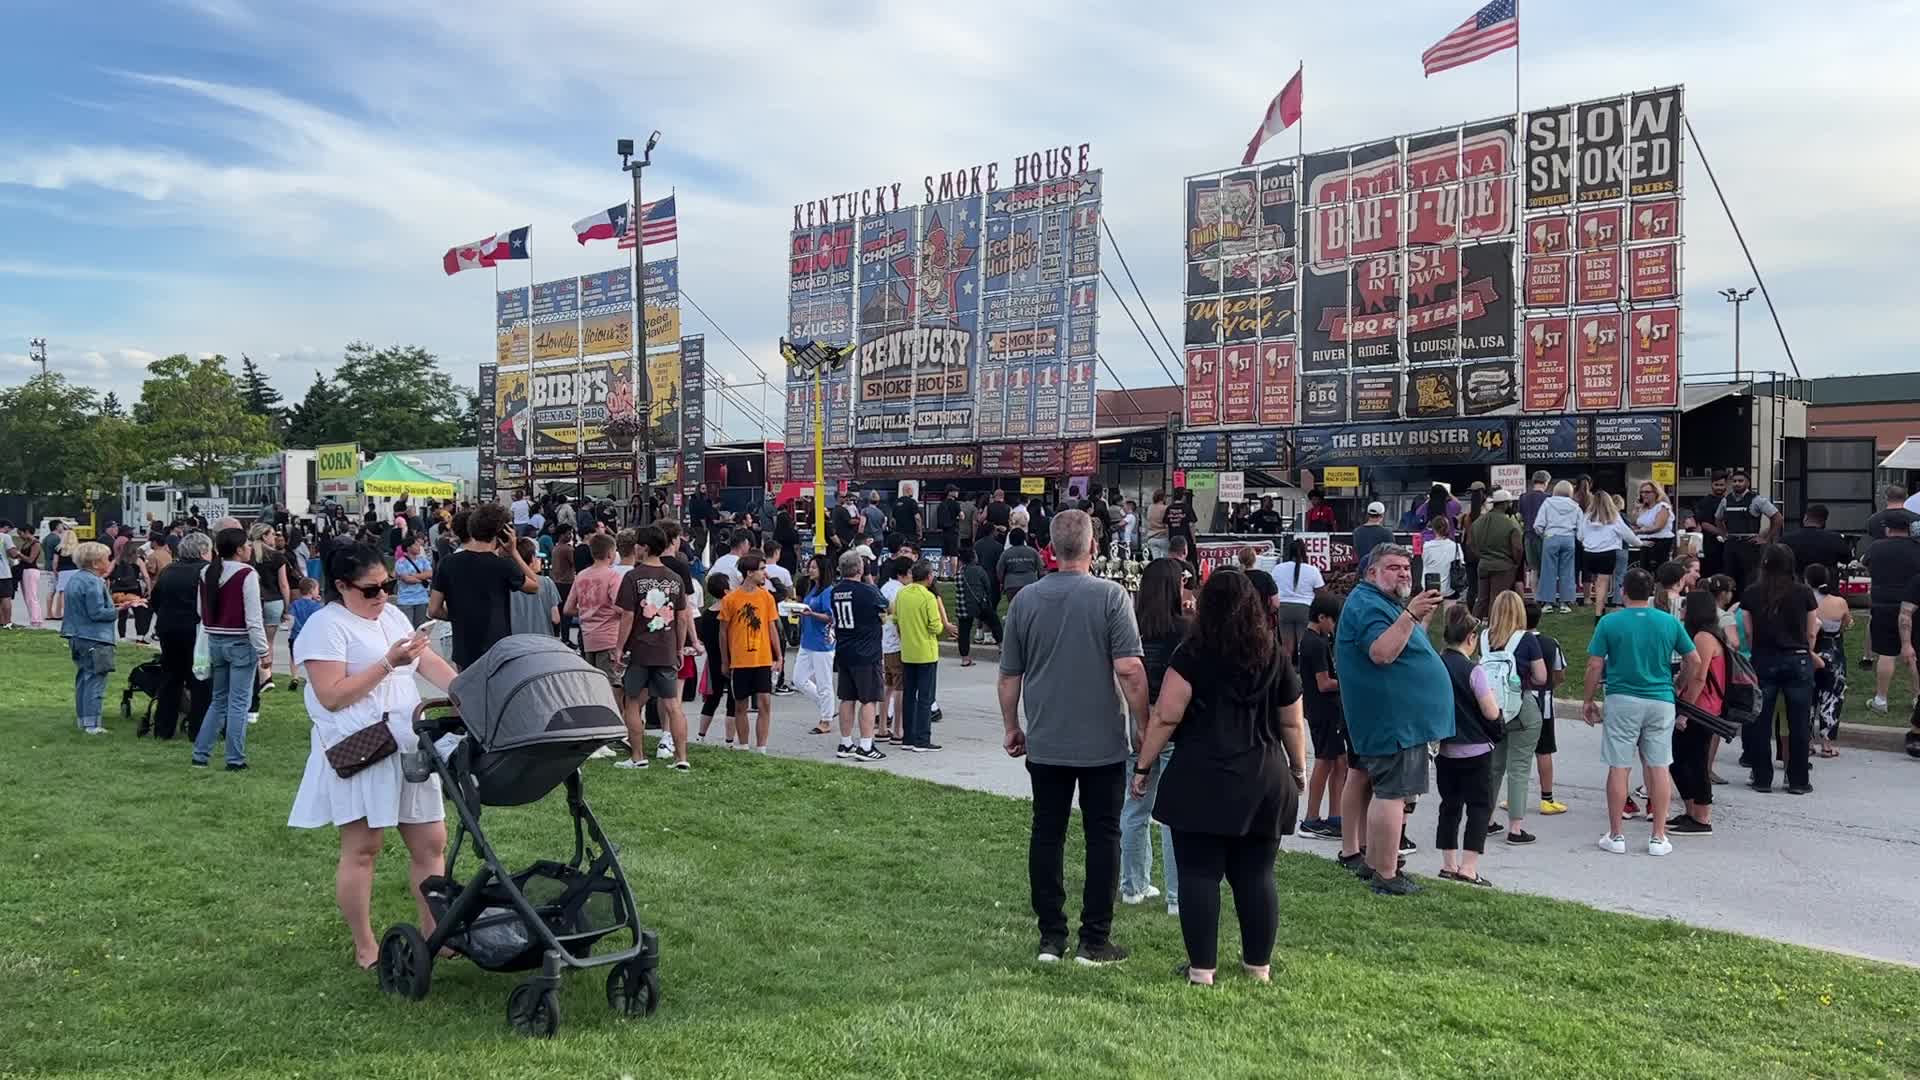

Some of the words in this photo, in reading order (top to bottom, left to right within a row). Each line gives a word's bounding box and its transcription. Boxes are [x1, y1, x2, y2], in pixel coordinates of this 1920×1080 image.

[1529, 96, 1674, 151] SLOW
[1531, 138, 1671, 192] SMOKED
[1262, 174, 1293, 191] VOTE
[1330, 154, 1496, 203] LOUISIANA
[794, 183, 902, 231] KENTUCKY
[925, 163, 999, 203] SMOKE
[1015, 143, 1090, 186] HOUSE
[1580, 187, 1621, 201] STYLE
[1631, 180, 1674, 194] RIBS
[862, 219, 885, 231] VOTE
[988, 228, 1032, 258] Feeling
[862, 241, 906, 264] CHOICE
[1638, 249, 1667, 259] BEST
[1369, 246, 1448, 279] BEST
[1533, 264, 1560, 275] BEST
[1586, 258, 1612, 269] BEST
[1638, 265, 1666, 275] RIBS
[831, 270, 850, 284] RIBS
[1368, 277, 1385, 290] IN
[1393, 264, 1447, 289] TOWN
[1532, 274, 1561, 285] SAUCE
[1587, 269, 1611, 281] RIBS
[1190, 295, 1274, 321] Where
[1341, 318, 1379, 335] BBQ
[1382, 313, 1420, 330] RB
[1423, 301, 1475, 322] TEAM
[794, 319, 845, 339] SAUCES
[860, 328, 970, 377] KENTUCKY
[1027, 347, 1056, 358] PORK
[1312, 348, 1345, 362] RIVER
[1480, 335, 1505, 349] USA
[1636, 355, 1669, 365] BEST
[1583, 365, 1613, 376] BEST
[867, 380, 911, 396] SMOKE
[917, 374, 963, 392] HOUSE
[1585, 376, 1612, 388] RIBS
[1635, 374, 1671, 384] SAUCE
[533, 368, 608, 408] BIBB'S
[1192, 390, 1212, 399] BEST
[1265, 386, 1288, 395] BEST
[1264, 395, 1289, 405] SAUCE
[1308, 390, 1337, 403] BBQ
[1190, 400, 1213, 409] SAUCE
[539, 409, 572, 421] TEXAS
[584, 408, 605, 419] BBQ
[918, 409, 970, 426] KENTUCKY
[1332, 434, 1357, 449] THE
[1361, 431, 1404, 447] BELLY
[1408, 428, 1469, 445] BUSTER
[1477, 430, 1503, 451] $44
[320, 451, 353, 471] CORN
[861, 455, 907, 467] HILLBILLY
[909, 453, 953, 466] PLATTER
[366, 483, 401, 493] Roasted
[404, 486, 429, 495] Sweet
[431, 486, 452, 496] Corn
[1306, 538, 1328, 553] EEF
[834, 601, 855, 629] 10
